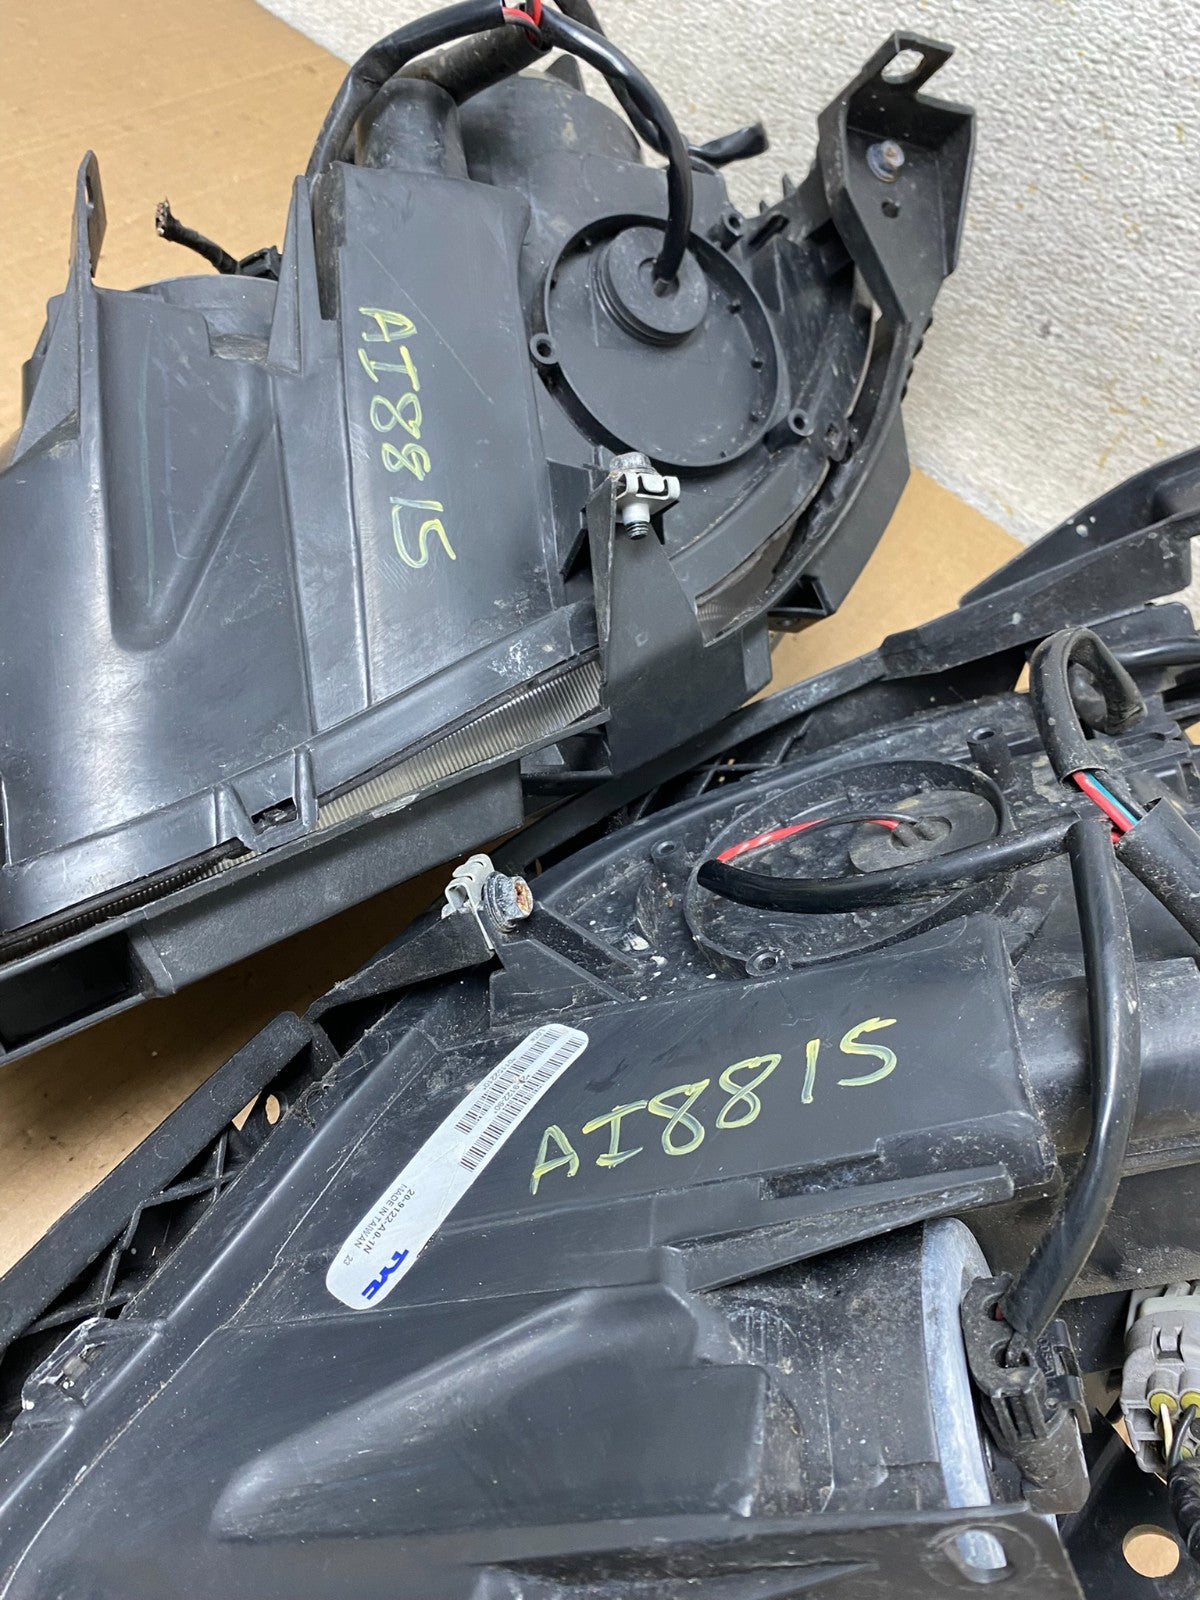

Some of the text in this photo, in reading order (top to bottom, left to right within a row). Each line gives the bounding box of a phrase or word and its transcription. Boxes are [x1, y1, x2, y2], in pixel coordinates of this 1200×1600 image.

[385, 1183, 408, 1208] MADE
[377, 1206, 389, 1217] IN
[354, 1216, 381, 1249] TAIWAN
[362, 1249, 409, 1300] TYC
